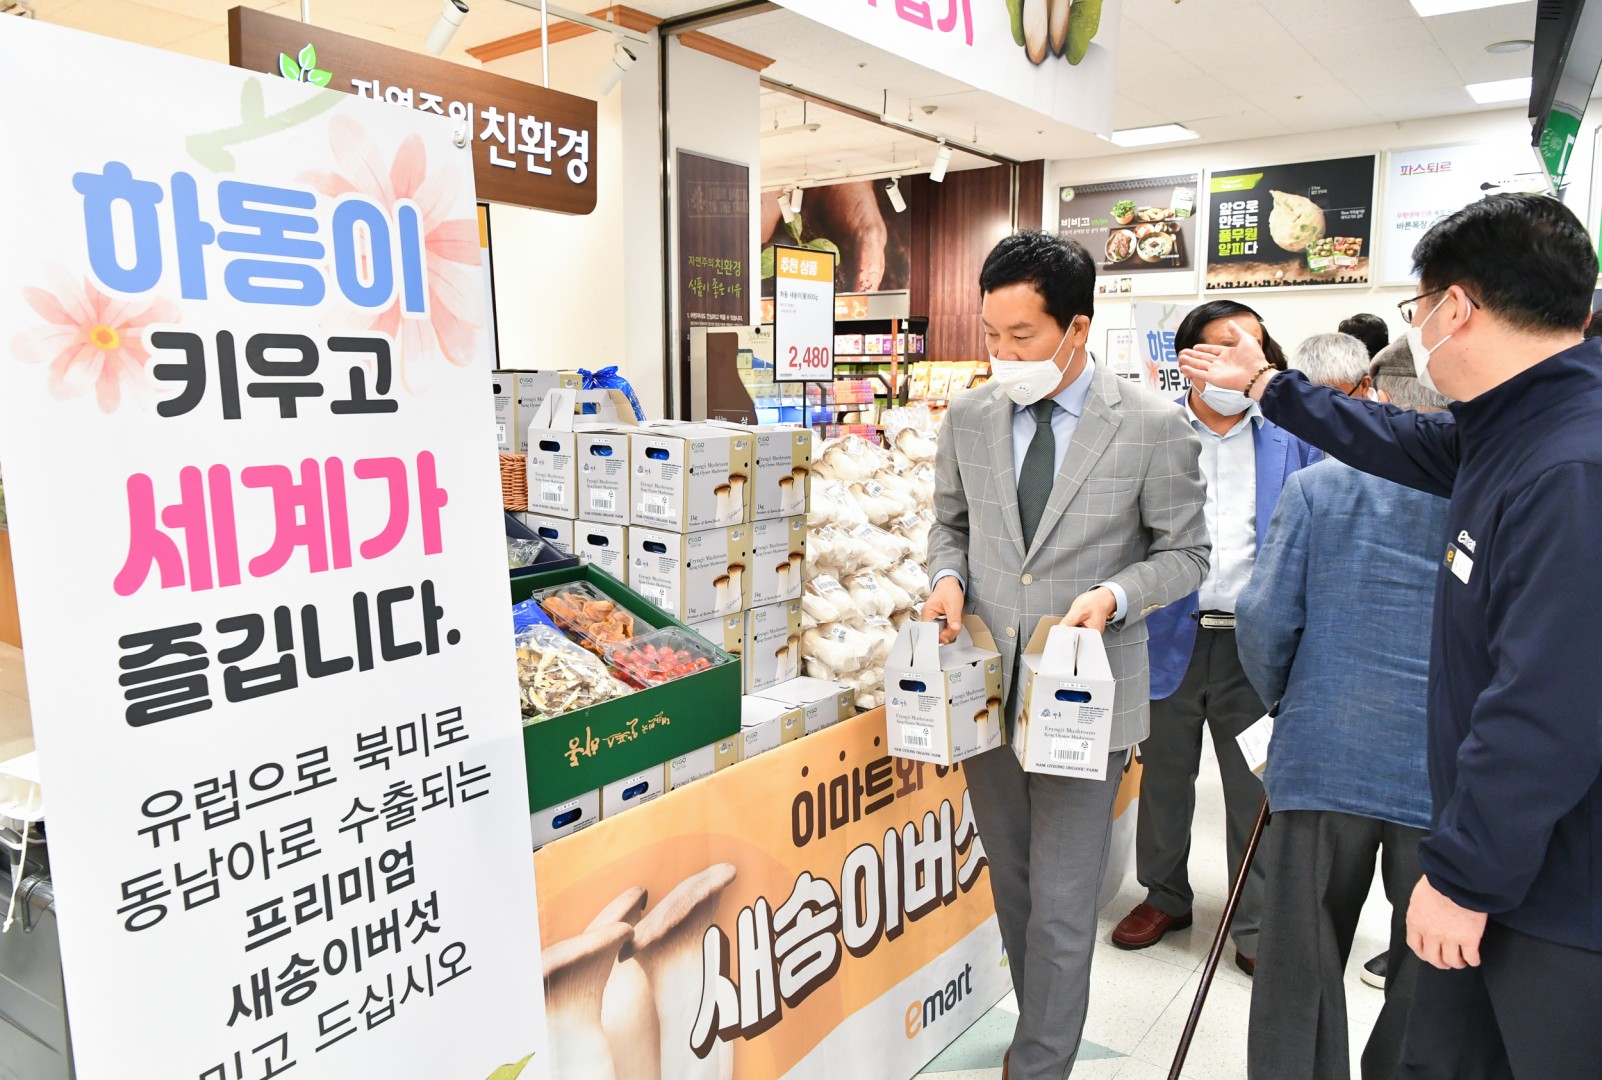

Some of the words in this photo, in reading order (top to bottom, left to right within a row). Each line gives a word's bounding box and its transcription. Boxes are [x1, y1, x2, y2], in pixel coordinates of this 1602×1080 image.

[480, 106, 588, 184] 친환경
[1400, 161, 1452, 176] 파스퇴르
[72, 161, 425, 313] 하동이
[1061, 217, 1090, 228] 비비고
[1218, 227, 1258, 242] 풀무원
[1219, 214, 1258, 229] 만두는
[1220, 200, 1258, 215] 앞으로
[715, 258, 741, 277] 친환경
[800, 260, 818, 276] 상품
[150, 330, 398, 420] 키우고
[789, 346, 829, 370] 2,480
[113, 451, 448, 596] 세계가
[118, 580, 460, 727] 즐깁니다.
[137, 746, 337, 848] 유럽으로
[352, 707, 469, 770] 북미로
[792, 755, 924, 848] 이마트와
[116, 818, 322, 932] 동남아로
[338, 761, 491, 844] 수출되는
[244, 841, 416, 953] 프리미엄
[226, 891, 440, 1028] 새송이버섯
[315, 941, 472, 1052] 드십시오
[905, 963, 972, 1039] emart
